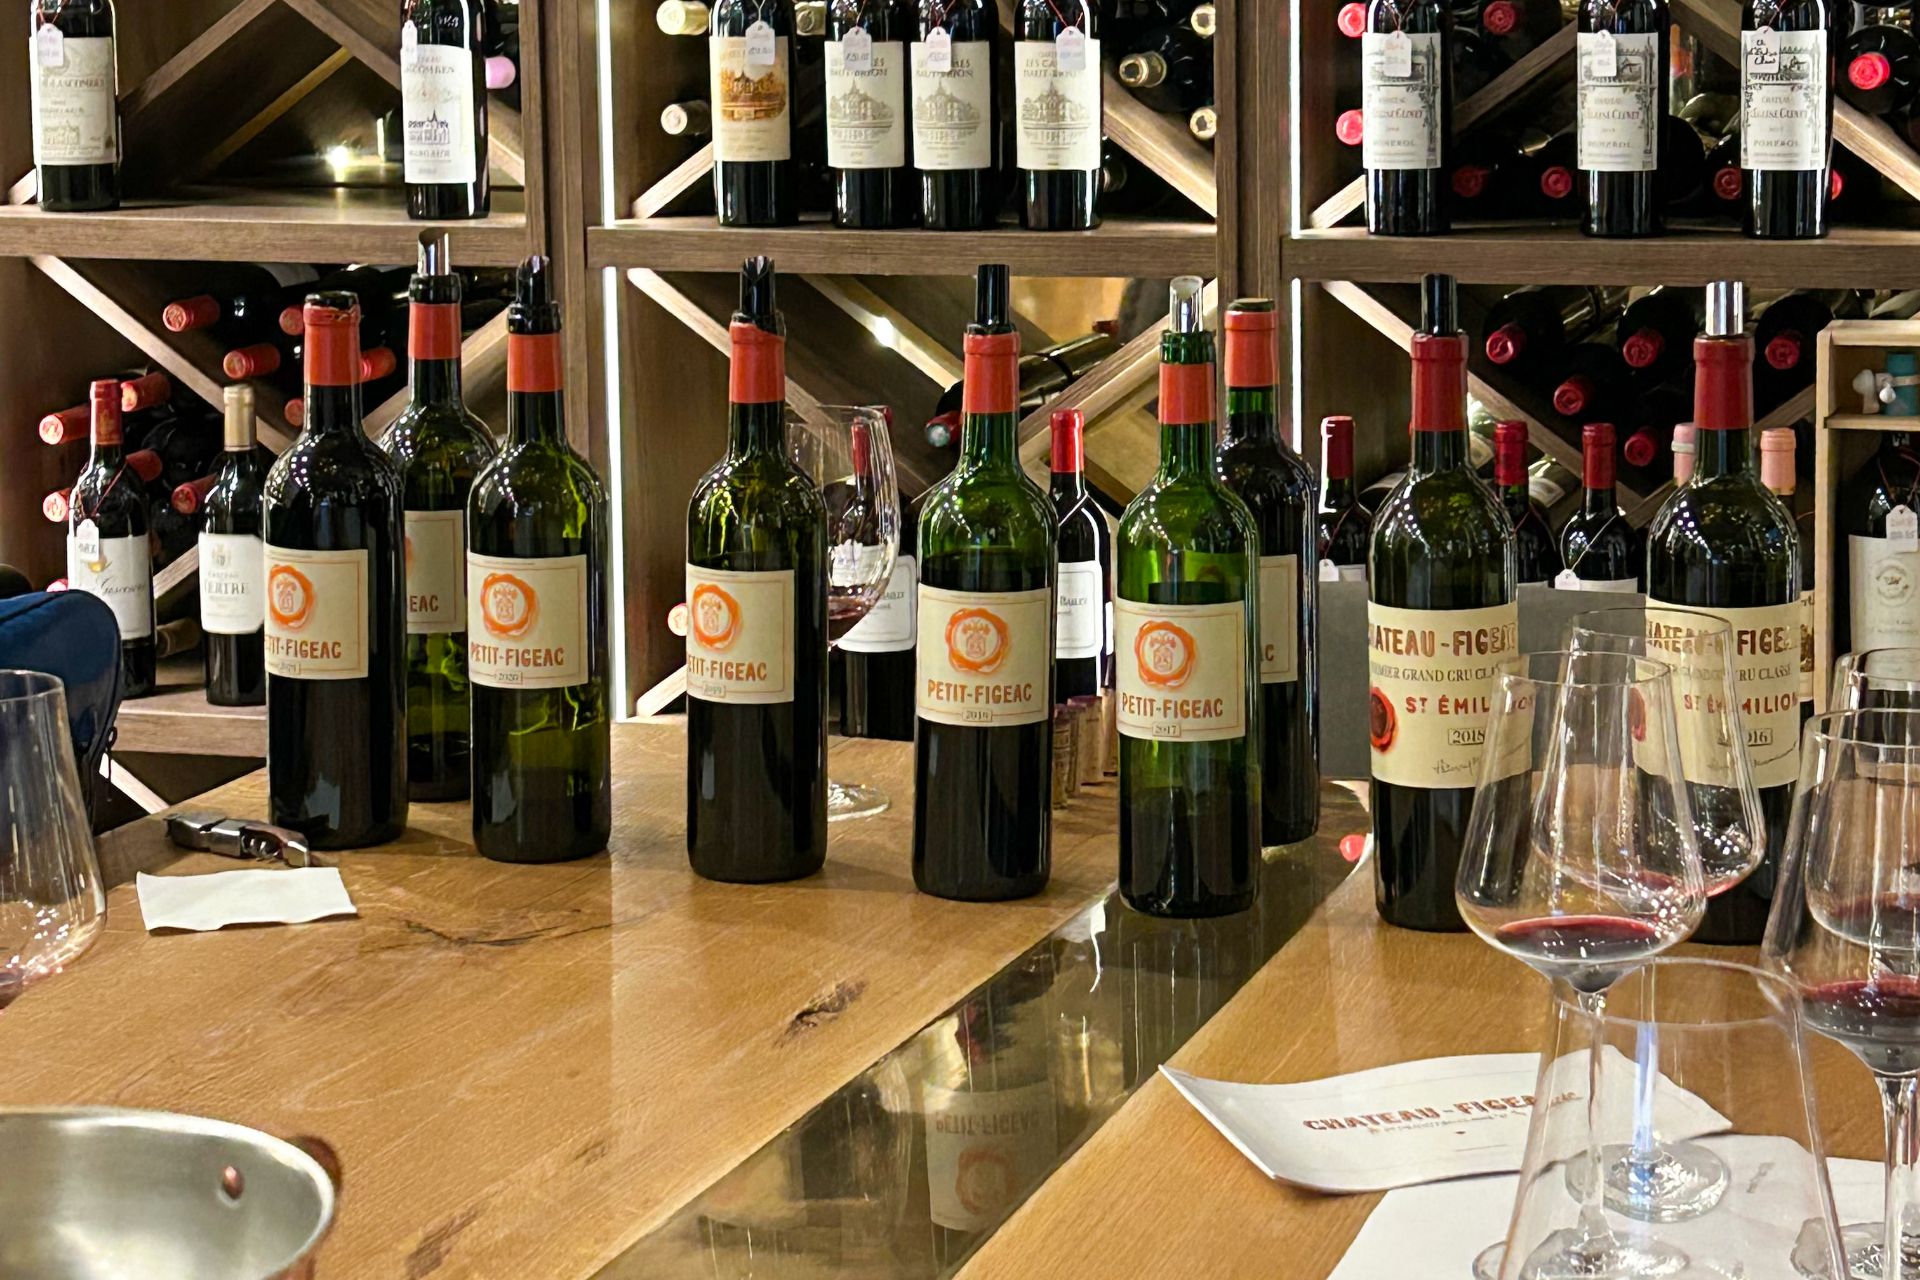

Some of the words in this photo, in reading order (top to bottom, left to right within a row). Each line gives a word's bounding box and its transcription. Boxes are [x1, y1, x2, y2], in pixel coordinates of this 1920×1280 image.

[688, 655, 767, 681] ETIT-FIGEAC
[1402, 668, 1444, 682] GRAND
[1447, 668, 1473, 683] CRU
[927, 679, 1032, 705] PETIT-FIGEAC
[1122, 692, 1224, 719] PETIT-FIGEAC
[1452, 729, 1485, 744] 2018
